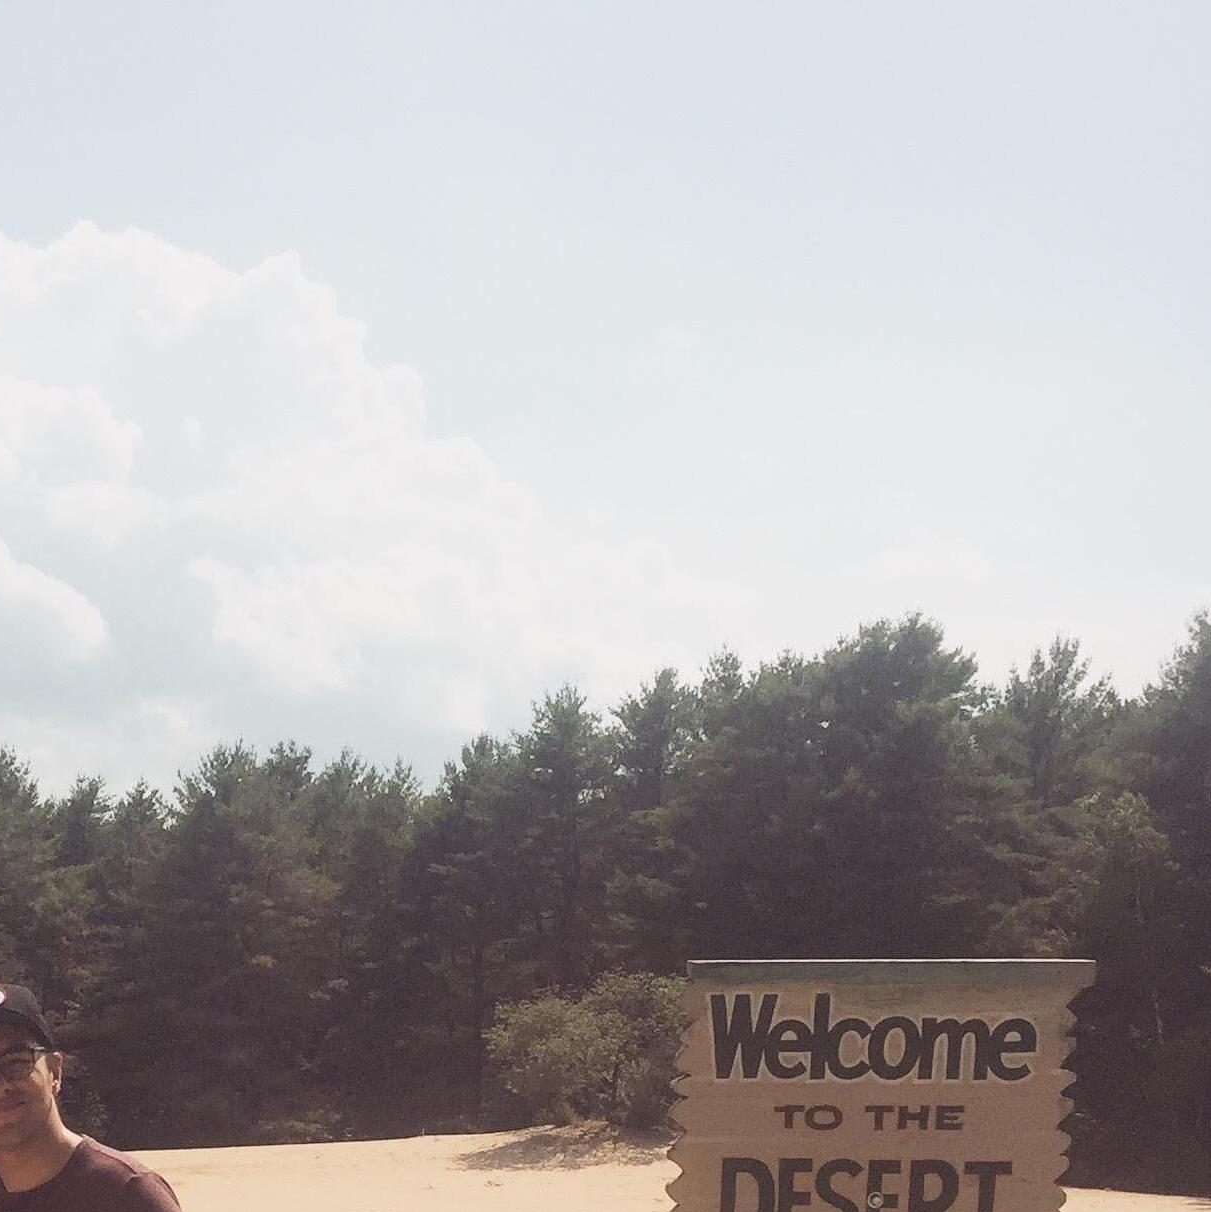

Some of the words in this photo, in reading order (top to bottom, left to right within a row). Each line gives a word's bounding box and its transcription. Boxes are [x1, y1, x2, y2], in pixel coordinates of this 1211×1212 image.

[710, 992, 1038, 1081] Welcome
[774, 1104, 844, 1131] TO
[865, 1105, 966, 1131] THE
